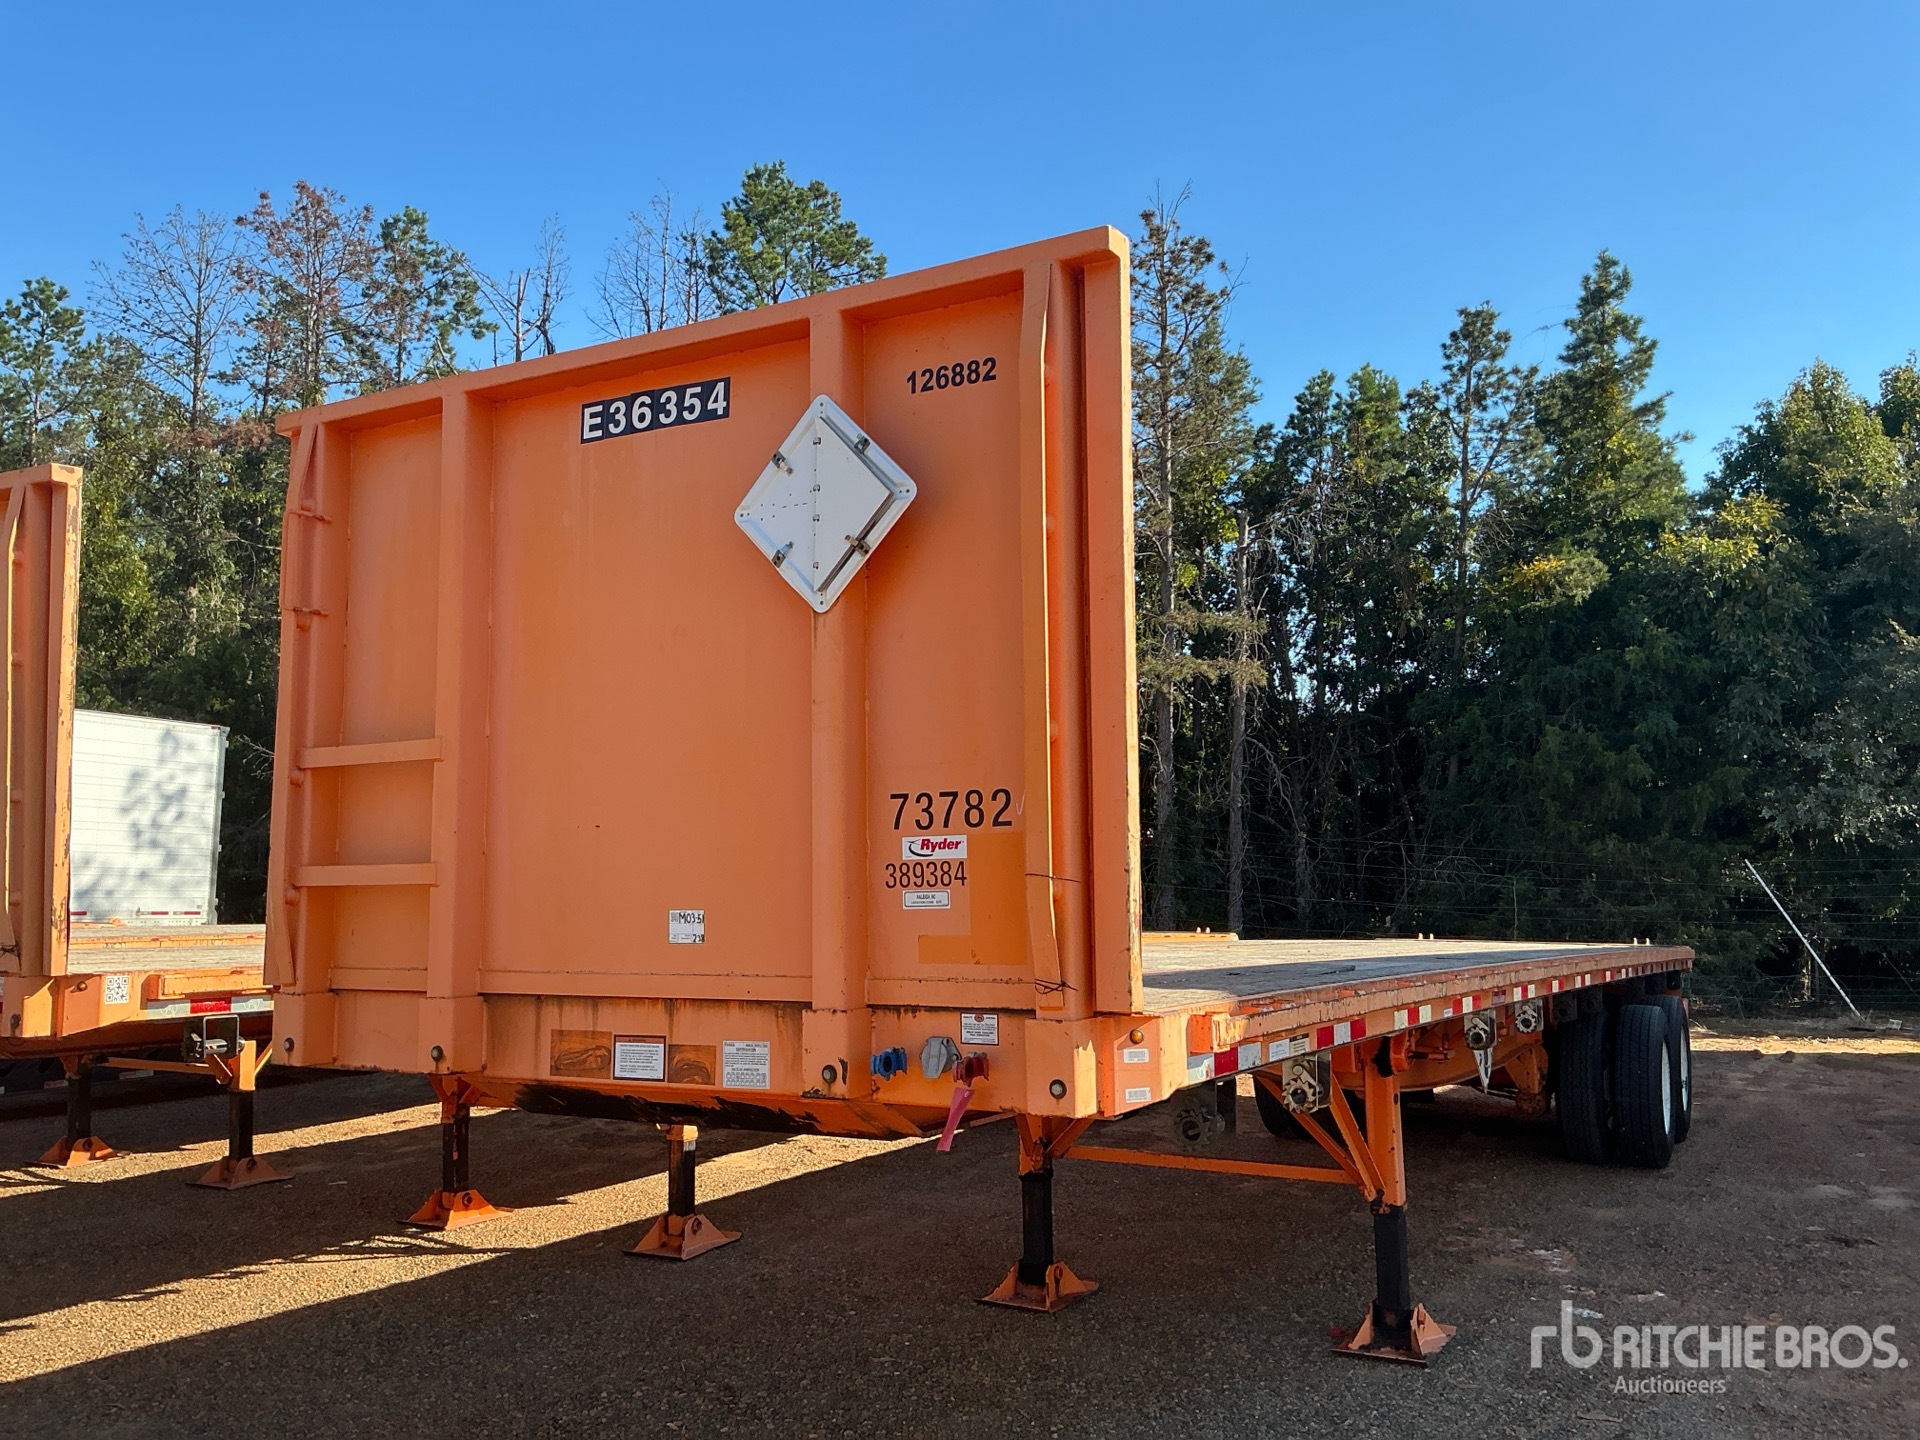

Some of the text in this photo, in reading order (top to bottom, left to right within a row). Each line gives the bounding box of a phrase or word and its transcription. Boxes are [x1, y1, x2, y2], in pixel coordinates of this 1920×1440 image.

[906, 356, 997, 395] 126882
[583, 381, 728, 440] E36354
[889, 788, 1013, 831] 73782
[919, 838, 962, 853] Ryder
[885, 860, 968, 889] 389384
